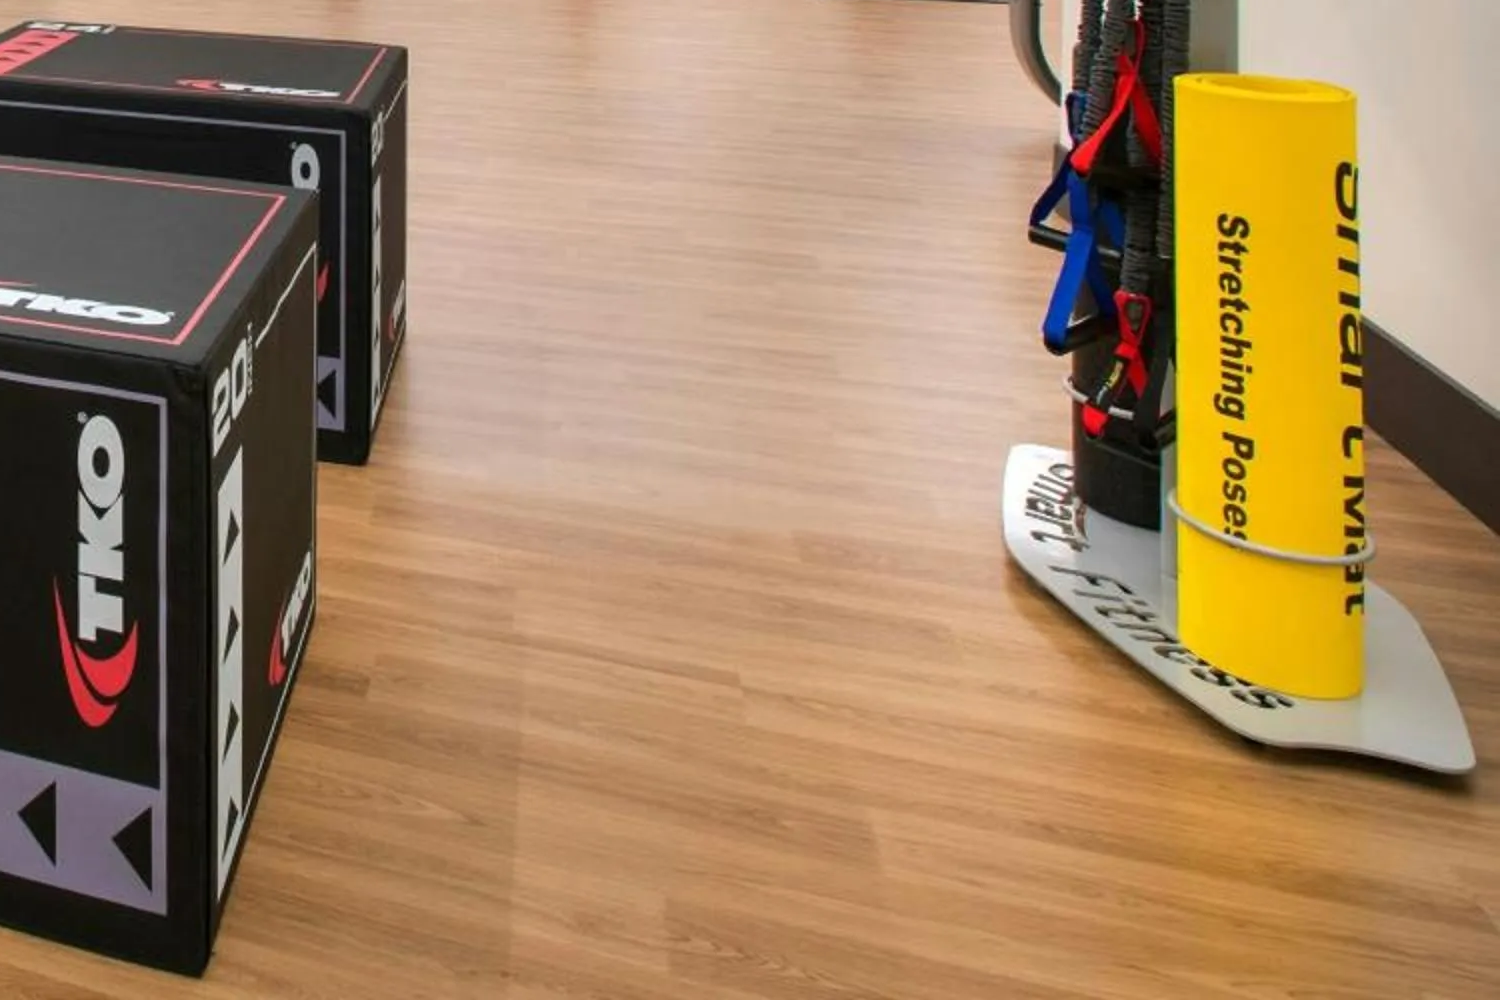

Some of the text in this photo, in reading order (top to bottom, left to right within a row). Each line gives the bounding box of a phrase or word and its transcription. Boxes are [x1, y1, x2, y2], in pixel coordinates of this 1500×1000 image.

[211, 338, 248, 459] 20
[1213, 212, 1253, 421] Stretching
[77, 414, 125, 642] TKO
[1047, 564, 1296, 709] Fitness
